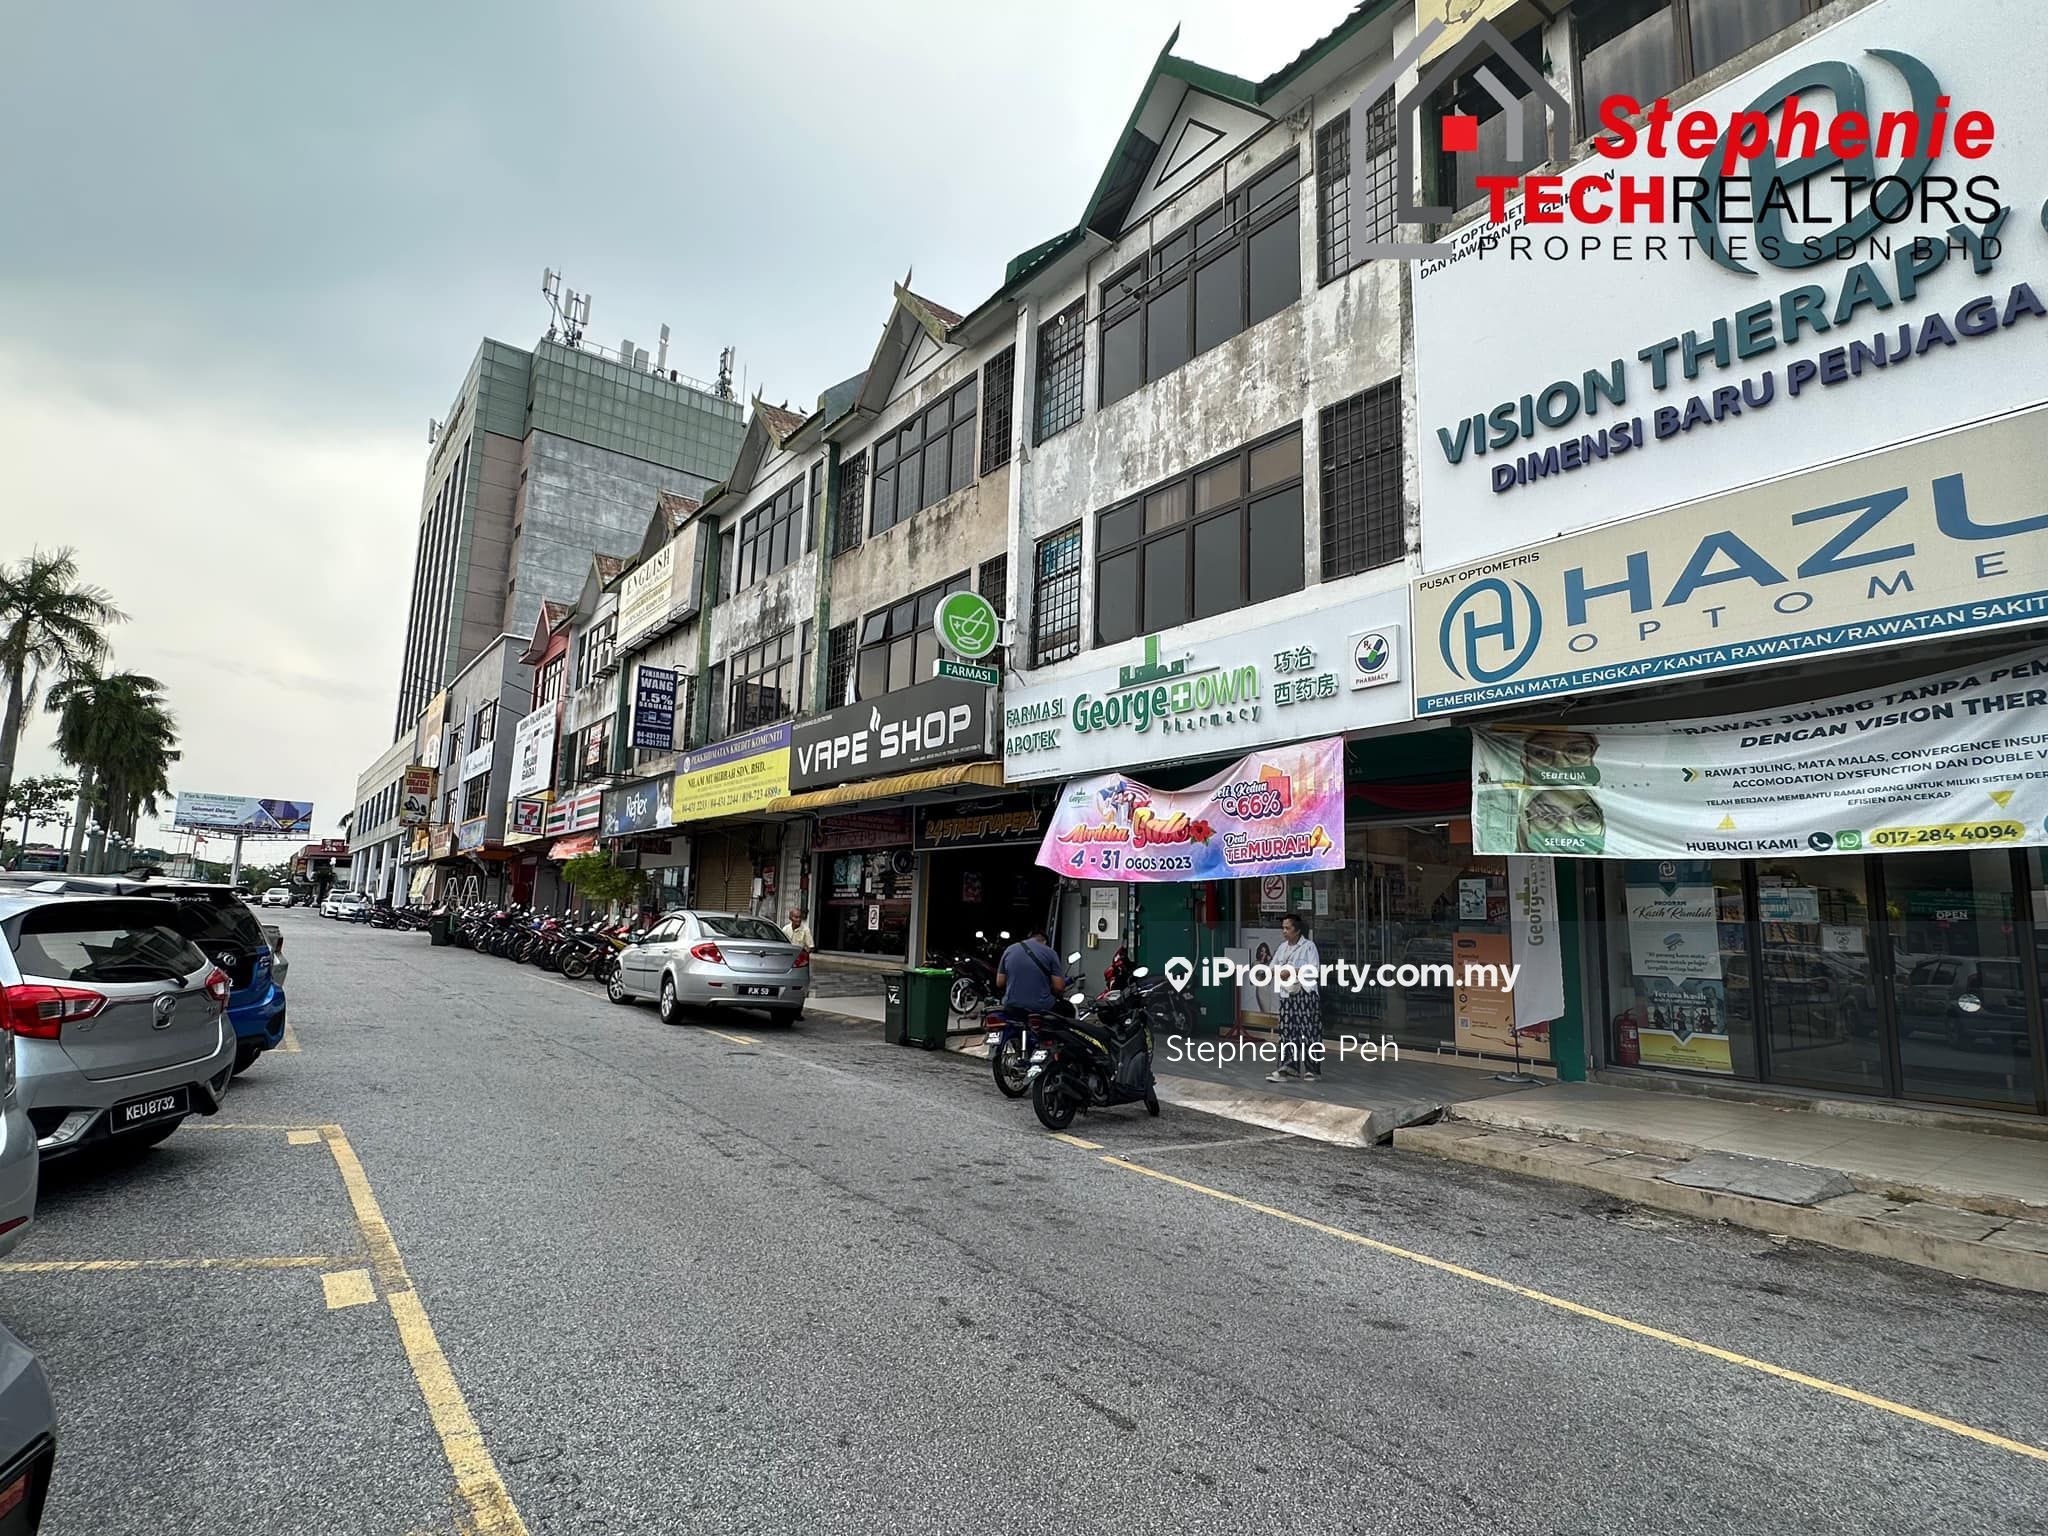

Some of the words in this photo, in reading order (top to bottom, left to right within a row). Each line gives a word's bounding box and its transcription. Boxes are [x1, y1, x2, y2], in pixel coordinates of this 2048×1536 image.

[1436, 358, 1625, 465] VISION
[1637, 205, 2011, 391] THERAPY
[1491, 417, 1643, 493] DIMENSI
[1653, 371, 1775, 440] BARU
[1787, 282, 2047, 396] PENJAGA
[627, 547, 670, 596] ENGLISH
[1419, 577, 1455, 592] PUSAT
[1458, 552, 1540, 581] OPTOMETRIS
[1426, 684, 1525, 709] PEMERIKSAAN
[1527, 676, 1569, 692] MATA
[1972, 596, 2048, 619] SAKIT
[641, 669, 674, 681] PINJAMAN
[641, 678, 673, 692] WANG
[946, 664, 991, 681] FARMASI
[1355, 673, 1389, 684] PHARMACY
[640, 692, 673, 705] 1.5%
[1273, 673, 1335, 704] 西药房
[1882, 676, 1981, 706] TANPA
[1006, 698, 1065, 727] FARMASI
[1163, 704, 1261, 735] Pharmacy
[1739, 722, 1847, 748] DENGAN
[1855, 702, 1954, 732] VISION
[1961, 688, 2047, 716] THER
[798, 730, 869, 775] VAPE
[879, 704, 972, 759] SHOP
[1006, 729, 1060, 755] APOTEK
[1704, 766, 1747, 778] RAWAT
[1750, 760, 1796, 776] JULING,
[1798, 758, 1836, 770] MATA
[1838, 752, 1889, 767] MALAS,
[1891, 739, 2001, 763] CONVERGENCE
[1732, 771, 1834, 789] ACCOMODATION
[1836, 761, 1934, 780] DYSFUNCTION
[1936, 757, 1968, 769] DAN
[1971, 750, 2033, 766] DOUBLE
[1706, 799, 1733, 807] TELAH
[1735, 796, 1776, 806] BERJAYA
[1777, 791, 1832, 803] MEMBANTU
[1834, 788, 1866, 797] RAMAI
[1867, 784, 1904, 794] ORANG
[1906, 780, 1944, 791] UNTUK
[1946, 778, 1980, 788] MILIKI
[1982, 773, 2023, 784] SISTEM
[1848, 795, 1886, 806] EFISIEN
[1888, 793, 1912, 803] DAN
[1224, 832, 1246, 846] Deal
[1545, 837, 1585, 847] SELEPAS
[1686, 840, 1752, 852] HUBUNGI
[1757, 838, 1799, 850] KAMI
[1876, 829, 1955, 845] 017-284
[1960, 824, 2018, 840] 4094
[1071, 850, 1084, 868] 4
[1101, 849, 1121, 868] 31
[1125, 857, 1157, 870] OGOS
[1159, 856, 1193, 870] 2023
[1936, 910, 1968, 920] OPEN
